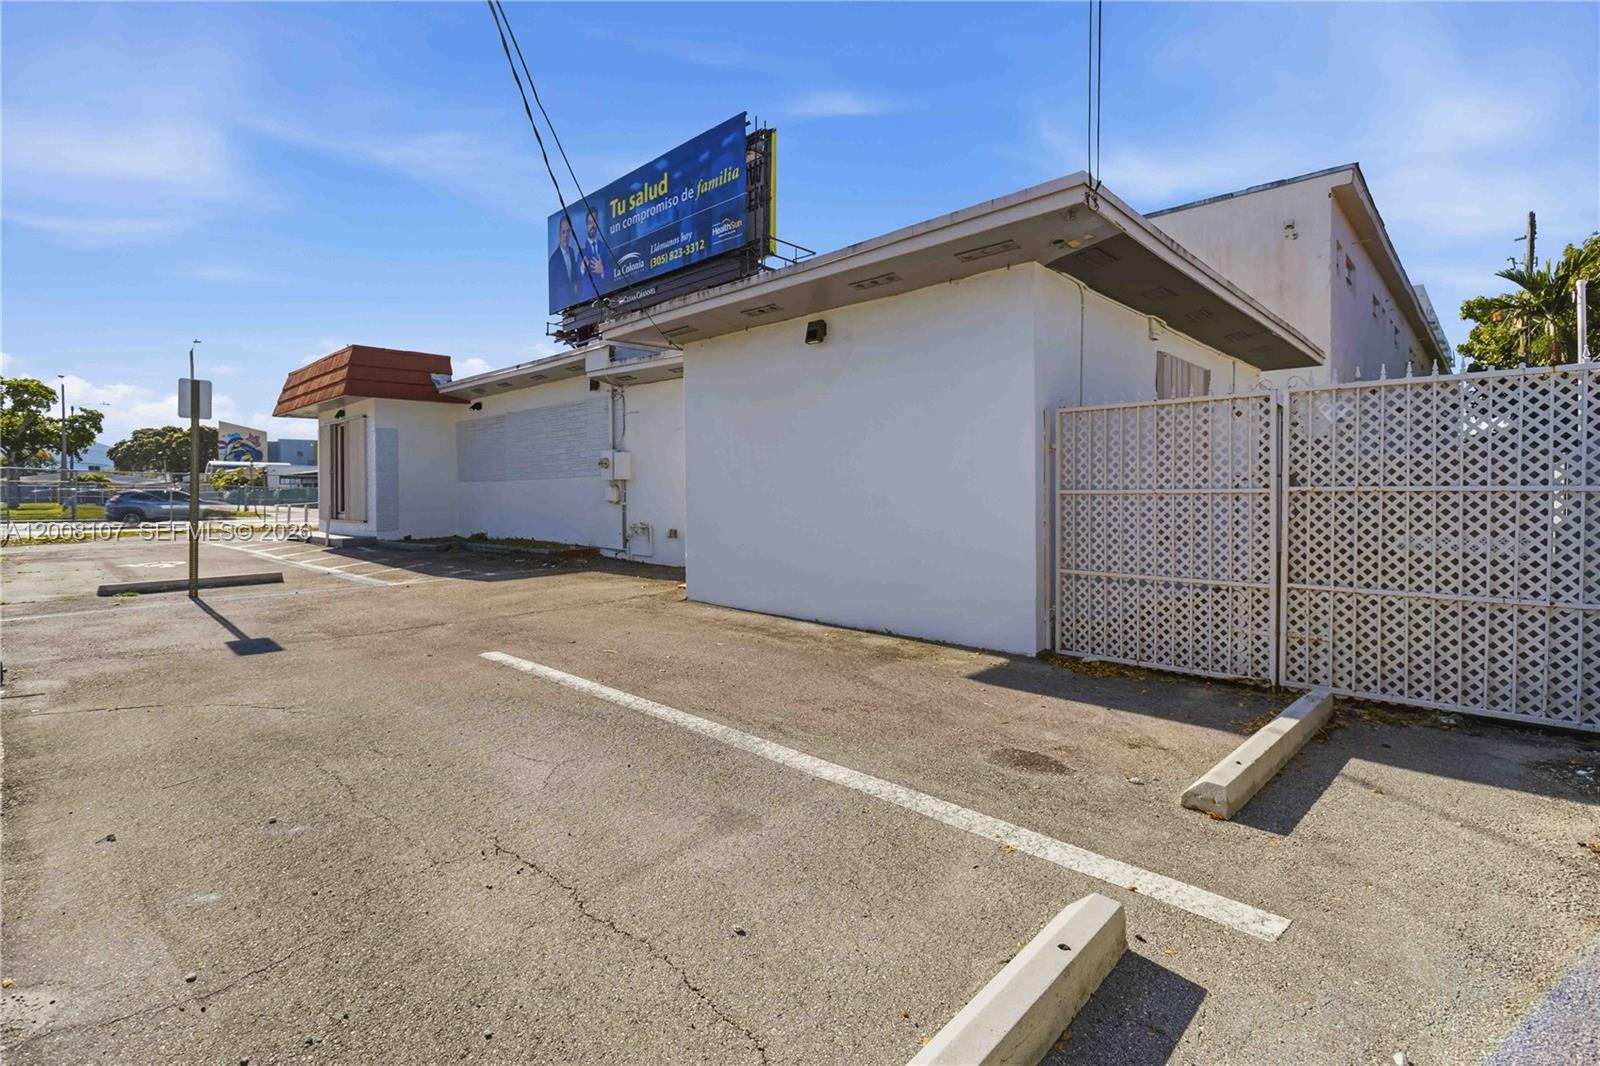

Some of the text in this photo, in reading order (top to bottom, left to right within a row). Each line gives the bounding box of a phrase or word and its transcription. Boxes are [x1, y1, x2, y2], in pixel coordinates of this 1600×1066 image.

[609, 172, 669, 218] Tu salud
[610, 166, 740, 234] un compromiso de familia
[680, 231, 693, 242] hoy
[613, 267, 621, 278] La
[621, 259, 645, 275] Colonia
[650, 239, 705, 269] (305) 823-3312
